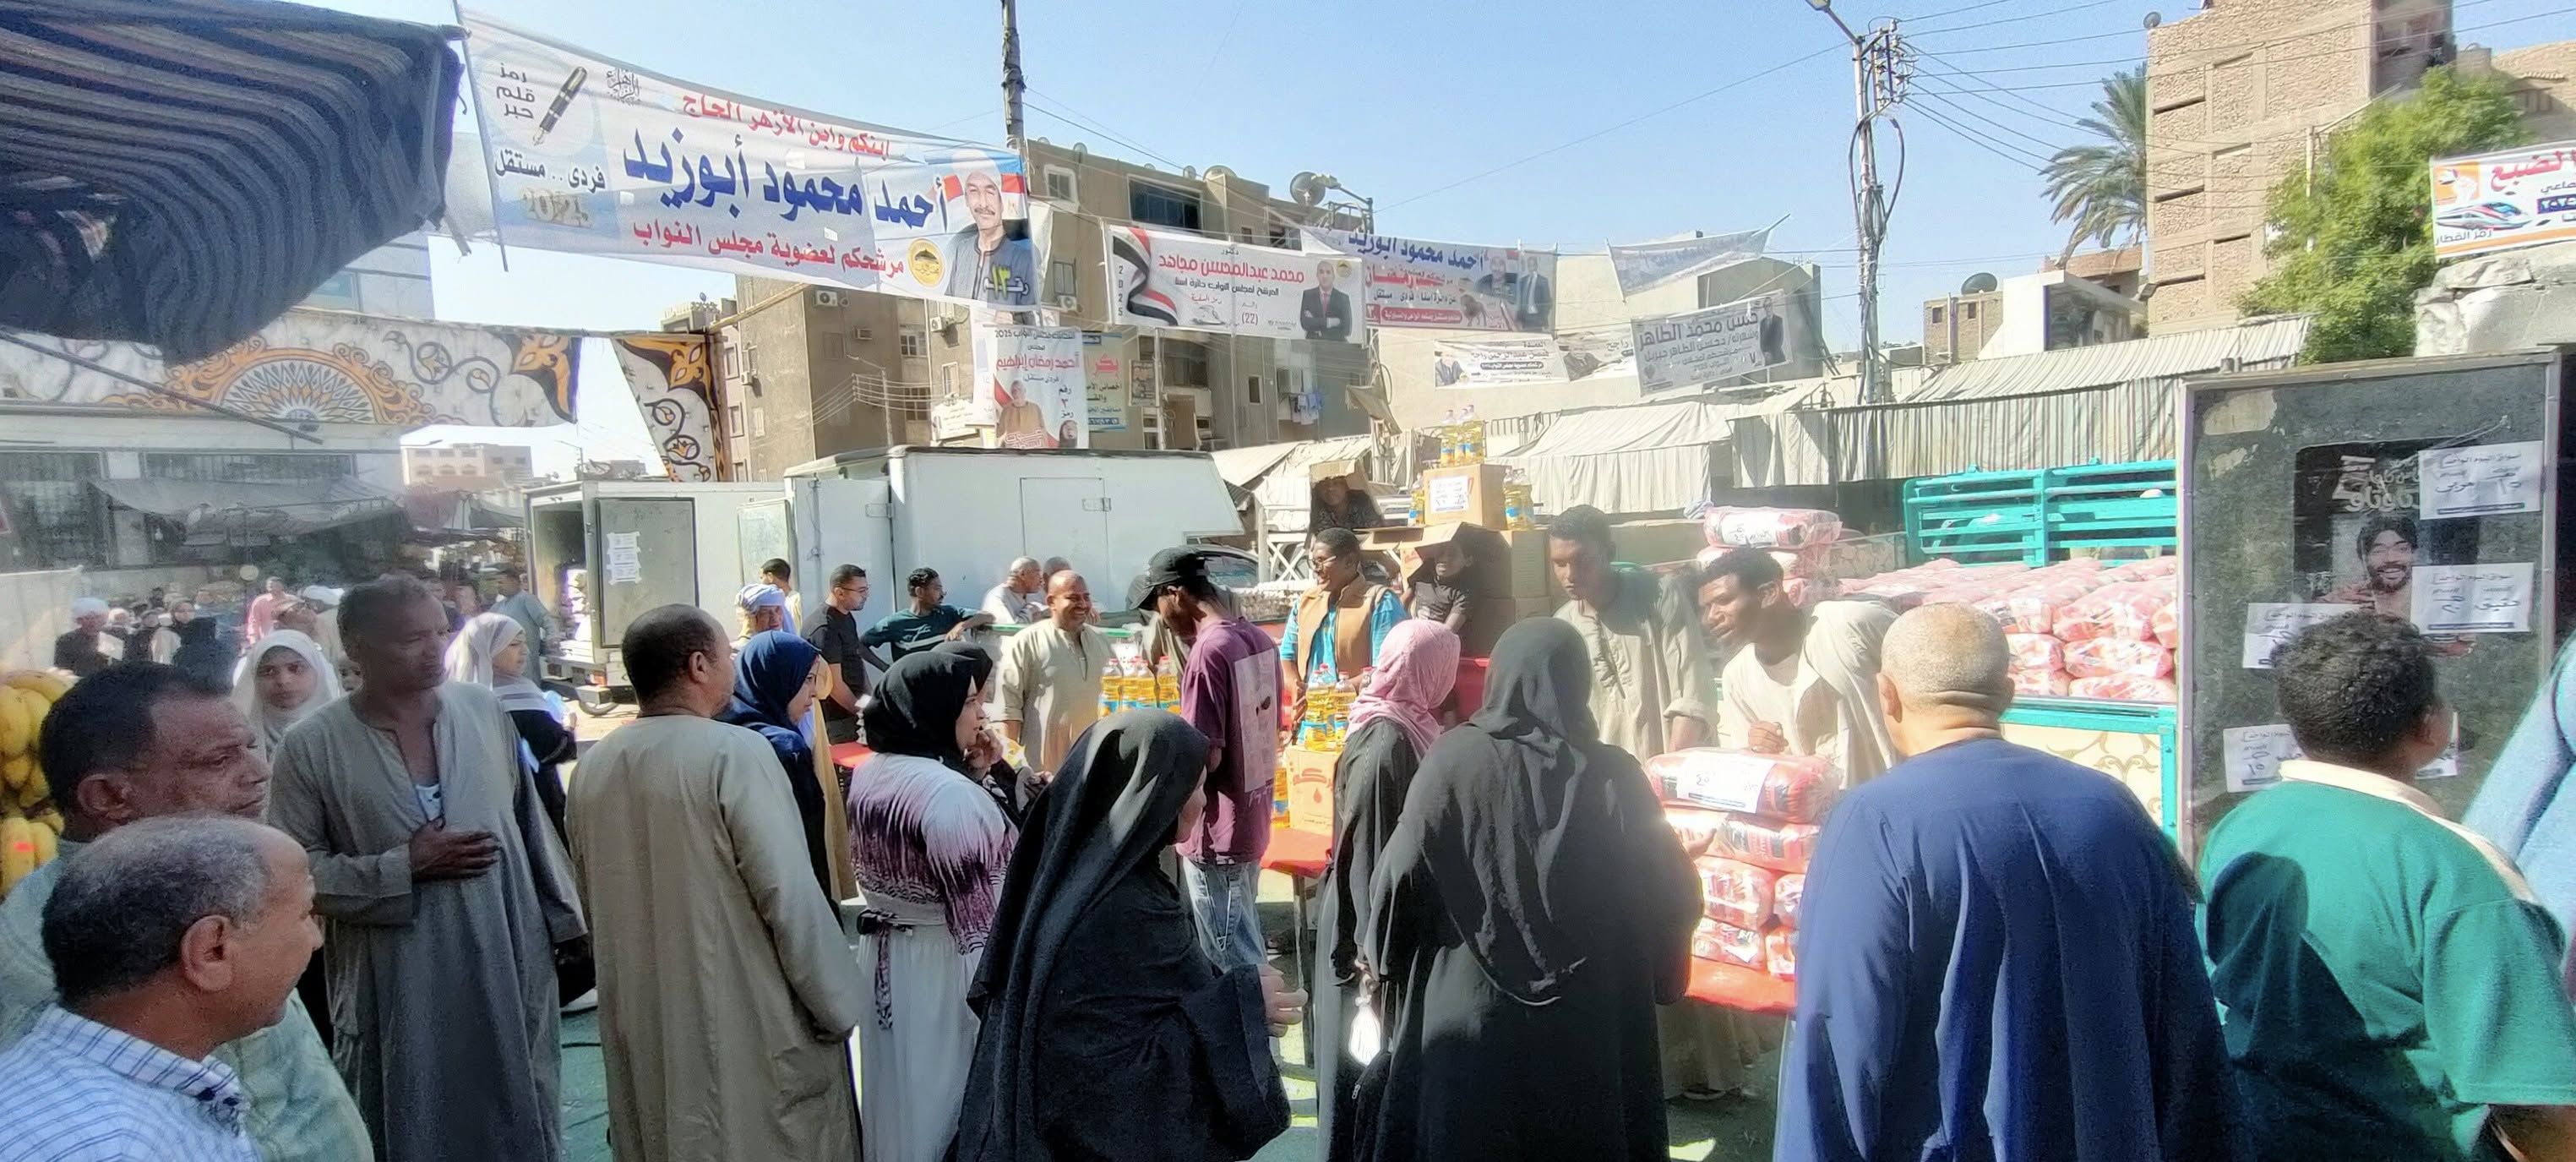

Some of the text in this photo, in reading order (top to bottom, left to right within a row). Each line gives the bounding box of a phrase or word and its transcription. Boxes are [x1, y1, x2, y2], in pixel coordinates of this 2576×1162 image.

[500, 63, 526, 83] رمز
[497, 85, 535, 103] قلم
[504, 103, 534, 119] حبر
[683, 93, 742, 123] الحاج
[809, 123, 846, 152] وابن
[848, 133, 891, 161] ابنكم
[494, 149, 546, 177] مستقل
[568, 166, 606, 194] فردى
[624, 127, 948, 232] أحمد محمود أبوزيد
[633, 220, 703, 248] النواب
[708, 229, 765, 260] مجلس
[2437, 229, 2492, 246] رمز القطار
[770, 231, 836, 269] لعضوية
[1400, 242, 1444, 264] محمود
[841, 244, 904, 279] مرشحكم
[1158, 254, 1304, 284] محمد عبدالمحسن مجاهد
[1447, 251, 1484, 271] احمد
[1189, 279, 1206, 289] دائرة
[1207, 281, 1230, 291] النواب
[1231, 281, 1255, 293] لمجلس
[1256, 286, 1279, 296] المرشح
[1241, 312, 1259, 326] (22)
[995, 330, 1012, 338] 2025
[1639, 312, 1758, 352] حسن محمد الطاهر
[996, 353, 1028, 371] إبراهيم
[1028, 354, 1054, 371] رمضان
